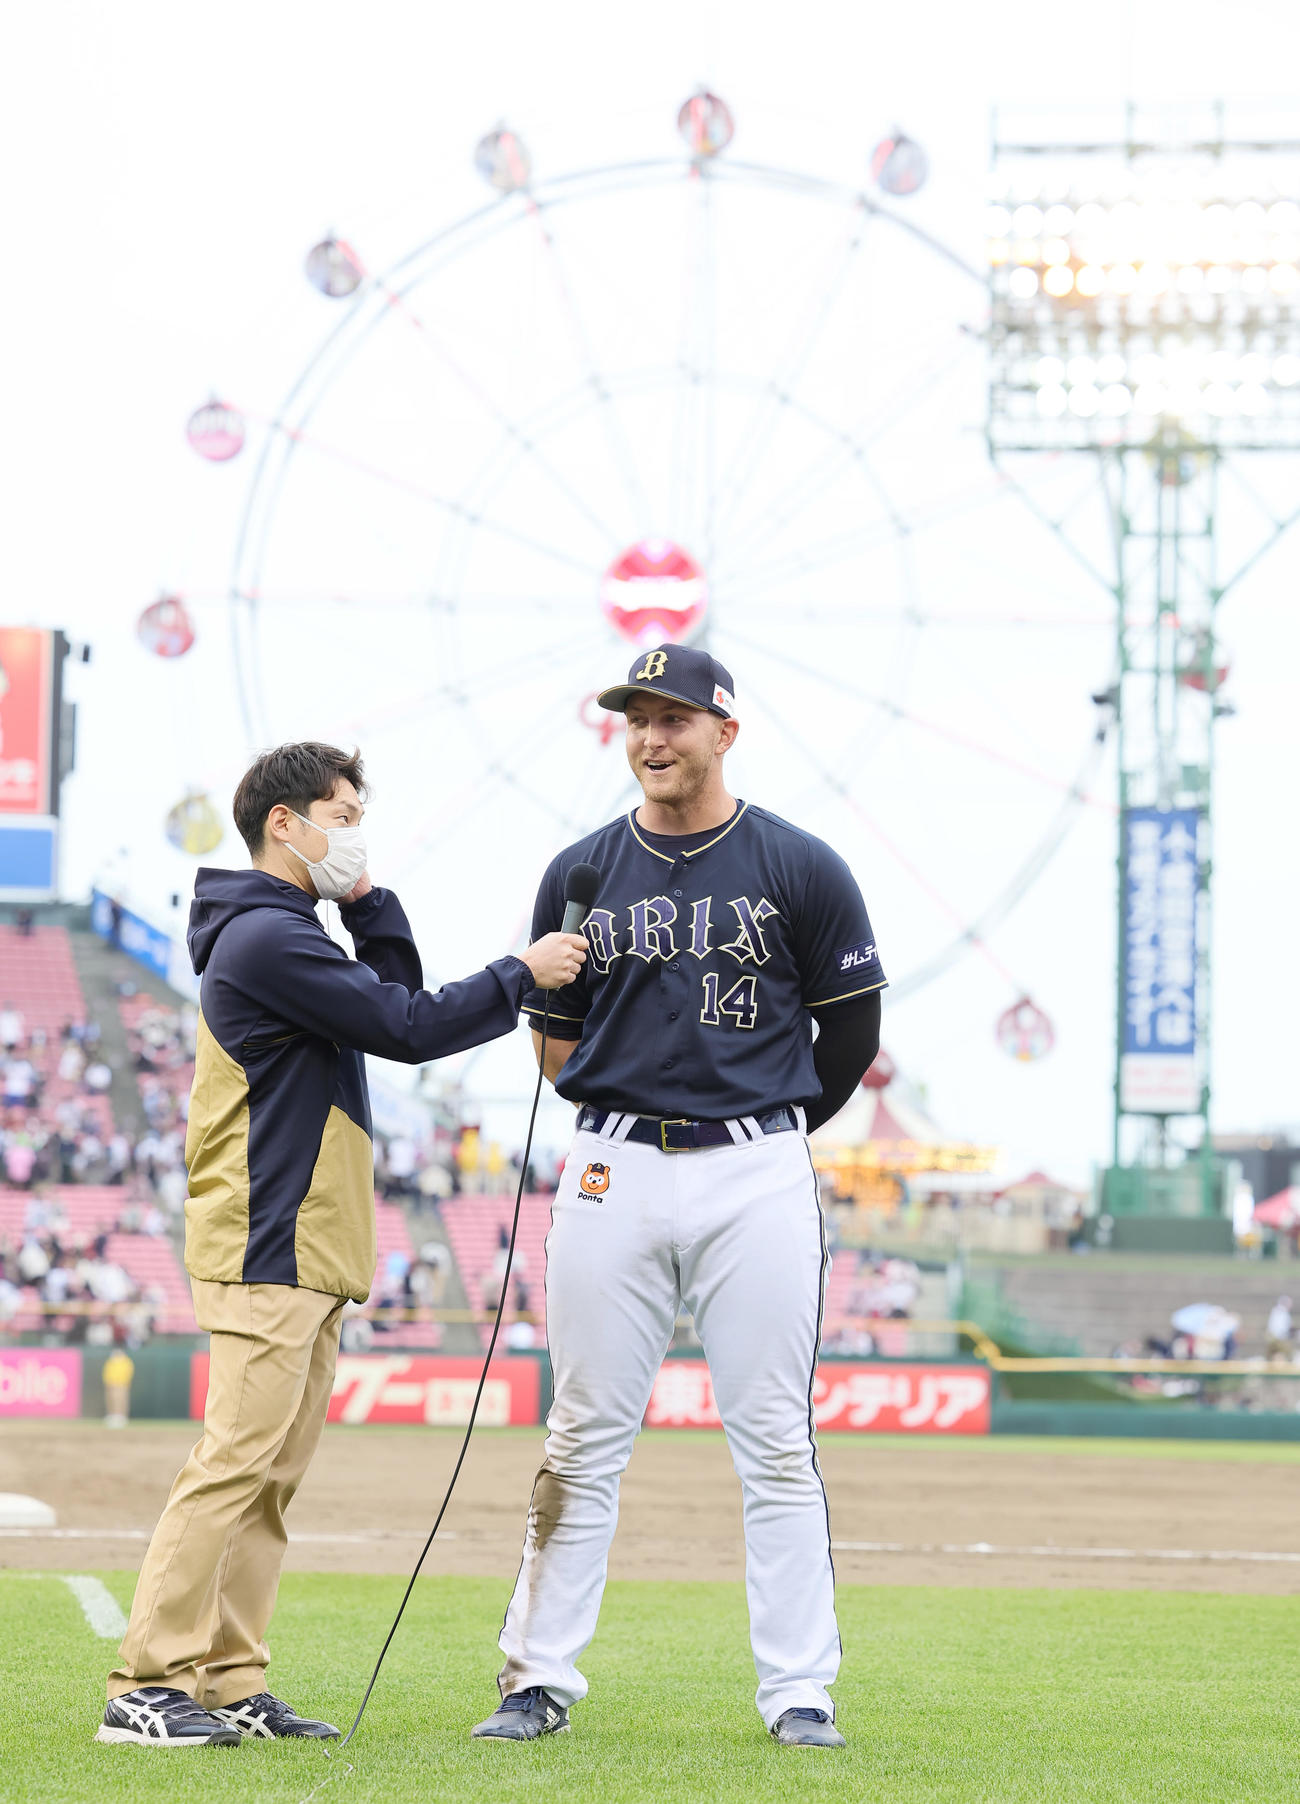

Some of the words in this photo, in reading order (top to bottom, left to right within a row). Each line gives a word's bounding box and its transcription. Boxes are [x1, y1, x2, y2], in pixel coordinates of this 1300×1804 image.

[636, 650, 669, 681] B
[579, 895, 779, 974] ORIX
[700, 972, 758, 1029] 14
